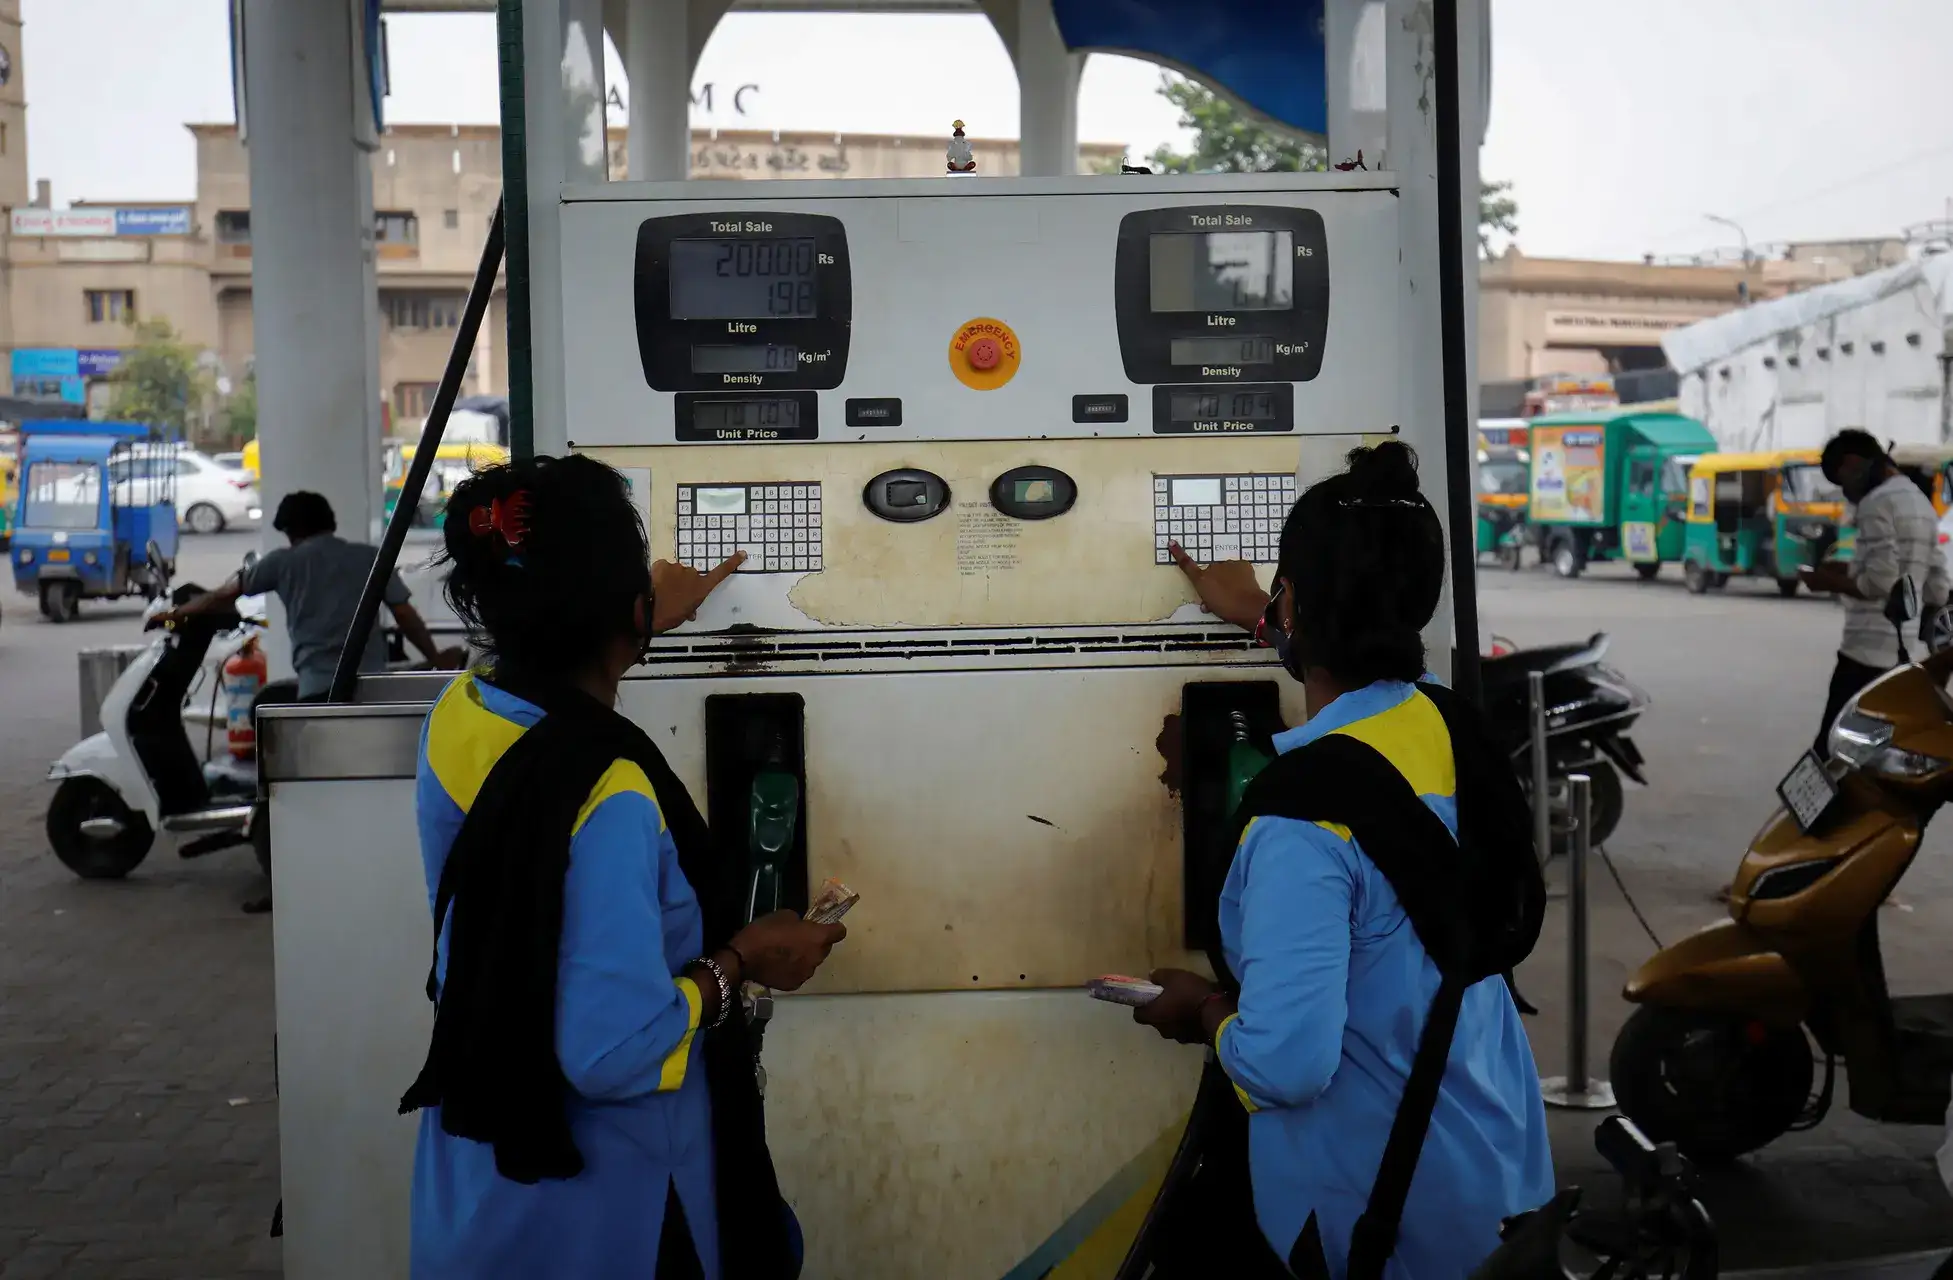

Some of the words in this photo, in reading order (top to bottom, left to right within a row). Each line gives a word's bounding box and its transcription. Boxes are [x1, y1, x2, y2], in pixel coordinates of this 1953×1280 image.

[1191, 215, 1222, 226] Total
[1225, 215, 1252, 226] Sale
[710, 221, 742, 233] Total
[746, 221, 773, 232] Sale
[1297, 246, 1313, 257] Rs
[818, 253, 834, 264] Rs
[1207, 315, 1236, 326] Litre
[728, 322, 757, 333] Litre
[955, 324, 1016, 360] EMERGENCY
[1202, 366, 1241, 378] Density
[723, 373, 763, 385] Density
[1193, 421, 1218, 431] Unit
[1223, 421, 1254, 431] Price
[716, 429, 742, 439] Unit
[747, 428, 778, 439] Price
